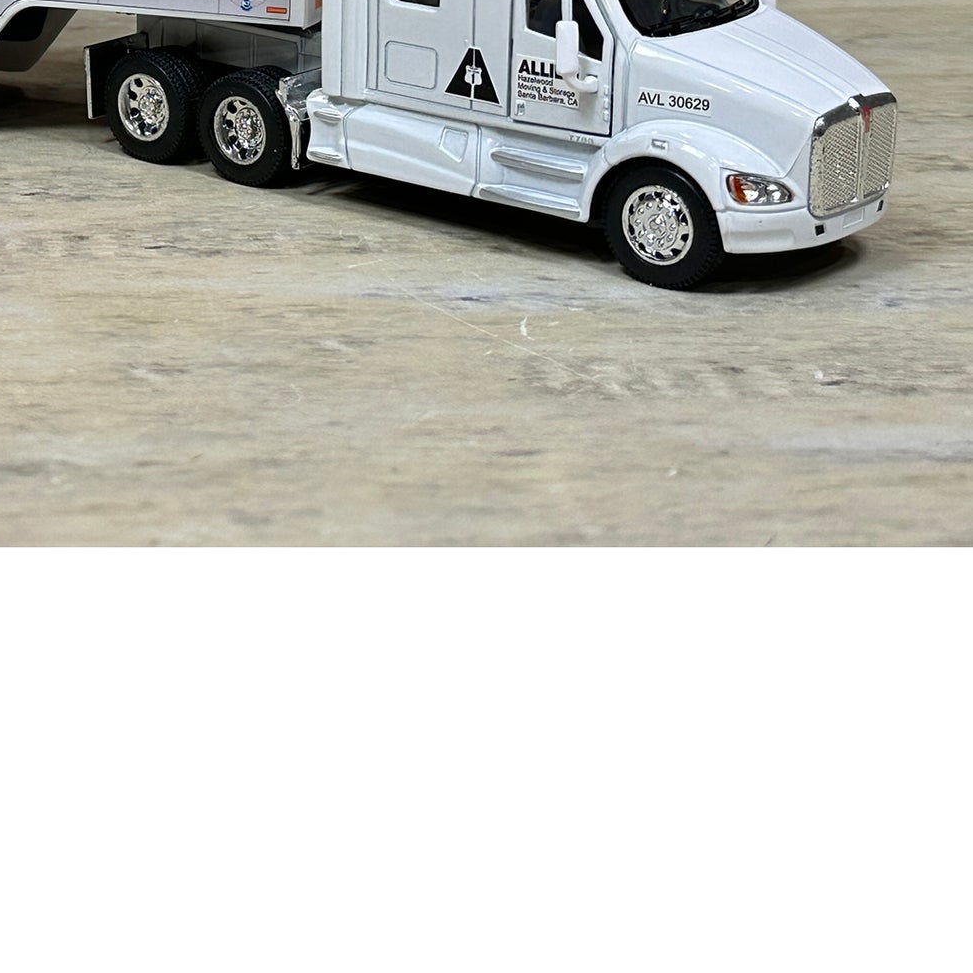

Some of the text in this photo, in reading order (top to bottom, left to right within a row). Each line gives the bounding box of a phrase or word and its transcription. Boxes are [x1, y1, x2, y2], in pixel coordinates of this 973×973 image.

[517, 74, 554, 86] Hazelwood
[517, 82, 541, 94] Moving
[549, 87, 575, 98] Storage
[517, 90, 537, 100] Santa
[567, 98, 578, 106] CA
[638, 91, 710, 111] AVL 30629
